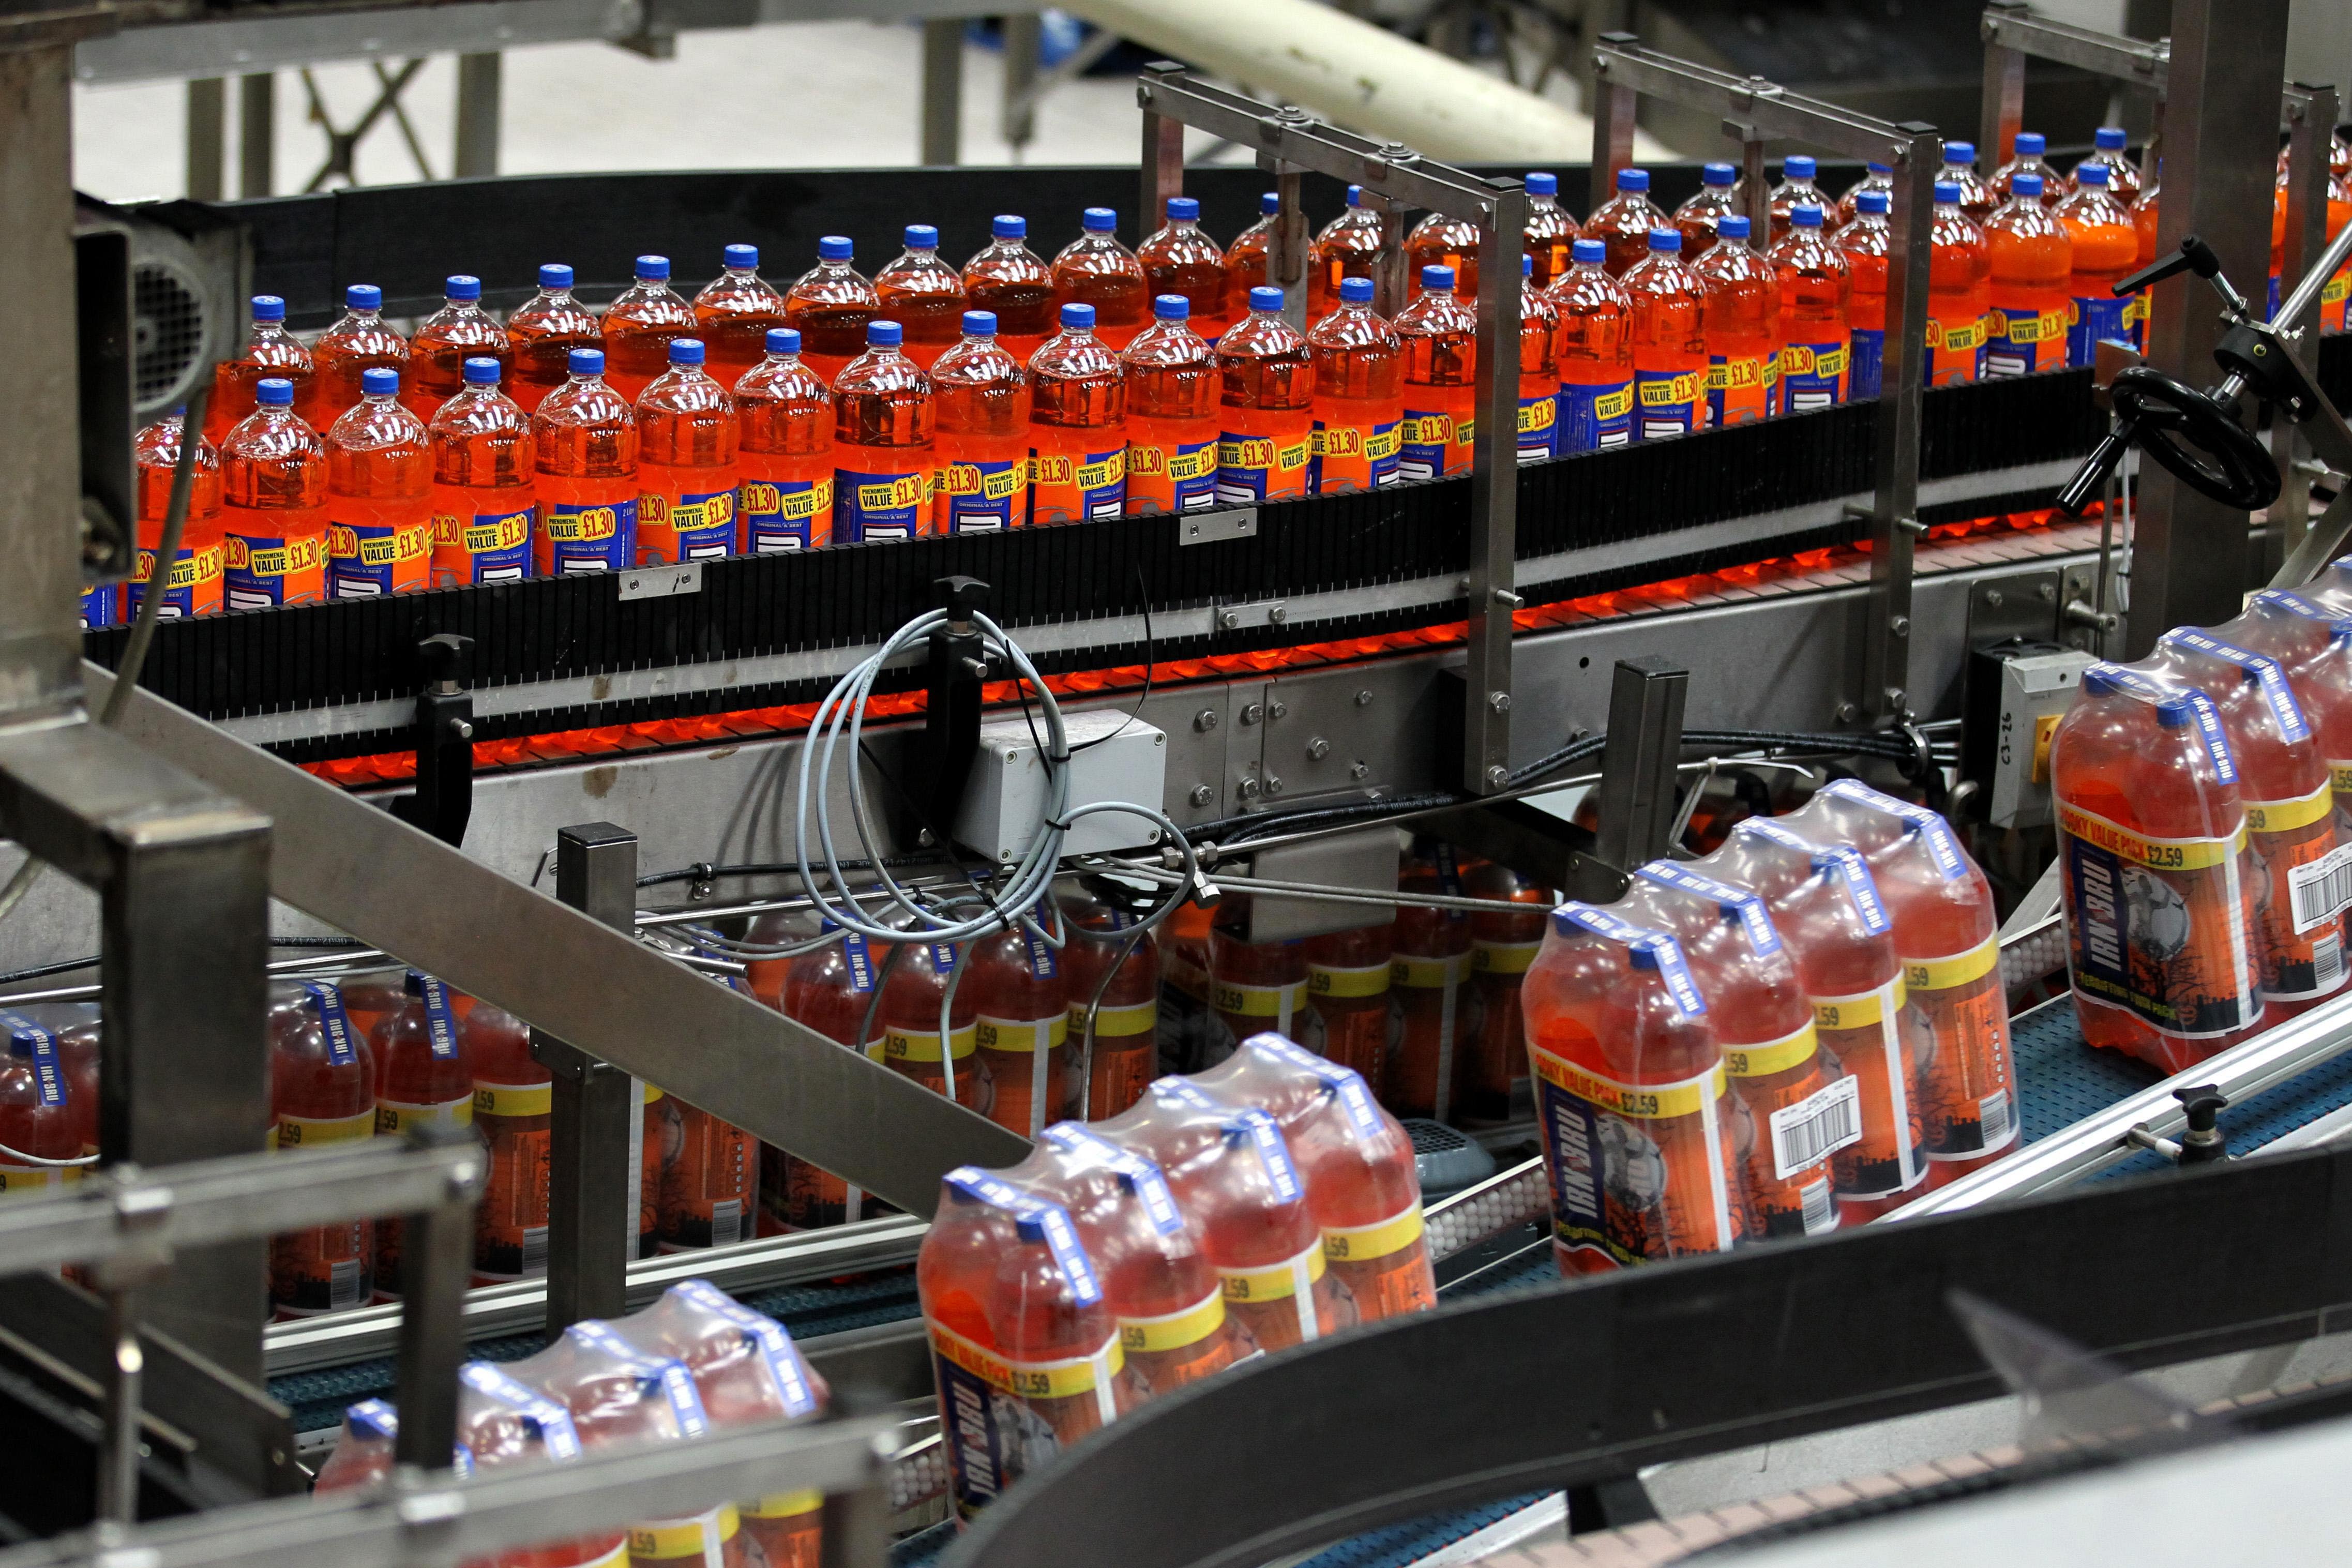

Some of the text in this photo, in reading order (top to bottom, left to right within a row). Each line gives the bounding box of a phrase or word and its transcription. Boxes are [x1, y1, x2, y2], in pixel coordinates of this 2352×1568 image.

[1784, 350, 1811, 372] £1.30
[1819, 361, 1841, 375] VALUE
[1732, 361, 1758, 385] £1.30
[1644, 390, 1671, 402] VALUE
[1675, 376, 1697, 401] £1.30
[1534, 402, 1554, 428] £1.30
[1599, 402, 1622, 417] VALUE
[1421, 418, 1451, 442] £1.30
[1281, 446, 1303, 456] PHENOMENAL
[1329, 431, 1358, 454] £1.30
[1367, 443, 1391, 458] VALUE
[1133, 449, 1161, 473] £1.30
[1170, 457, 1197, 465] PHENOMENAL
[1244, 442, 1273, 466] £1.30
[1282, 453, 1304, 468] VALUE
[948, 468, 978, 492] £1.30
[987, 474, 1013, 484] PHENOMENAL
[1041, 459, 1070, 482] £1.30
[1078, 465, 1105, 474] PHENOMENAL
[1079, 472, 1106, 487] VALUE
[1170, 463, 1198, 478] VALUE
[896, 477, 920, 506] £1.30
[988, 480, 1013, 495] VALUE
[639, 496, 665, 521] £1.30
[708, 495, 731, 525] £1.30
[747, 487, 776, 511] £1.30
[785, 495, 813, 504] PHENOMENAL
[786, 502, 813, 516] VALUE
[863, 494, 893, 507] VALUE
[673, 507, 703, 515] PHENOMENAL
[674, 514, 704, 528] VALUE
[466, 528, 496, 537] PHENOMENAL
[502, 517, 525, 547] £1.30
[549, 525, 579, 537] VALUE
[583, 510, 613, 538] £1.30
[329, 528, 354, 554] £1.30
[363, 540, 394, 549] PHENOMENAL
[399, 529, 424, 559] £1.30
[467, 535, 498, 549] VALUE
[199, 549, 220, 580] £1.30
[254, 552, 285, 560] PHENOMENAL
[291, 539, 316, 569] £1.30
[364, 547, 396, 562] VALUE
[254, 559, 287, 572] VALUE
[2001, 712, 2012, 765] C3-26
[2210, 741, 2233, 779] IRN-BRU
[2148, 845, 2183, 867] £2.59
[1031, 940, 1051, 976] IRN-BRU
[851, 953, 869, 989] IRN-BRU
[330, 1017, 349, 1056] IRN-BRU
[431, 1019, 451, 1056] IRN-BRU
[40, 1065, 59, 1102] IRN-BRU
